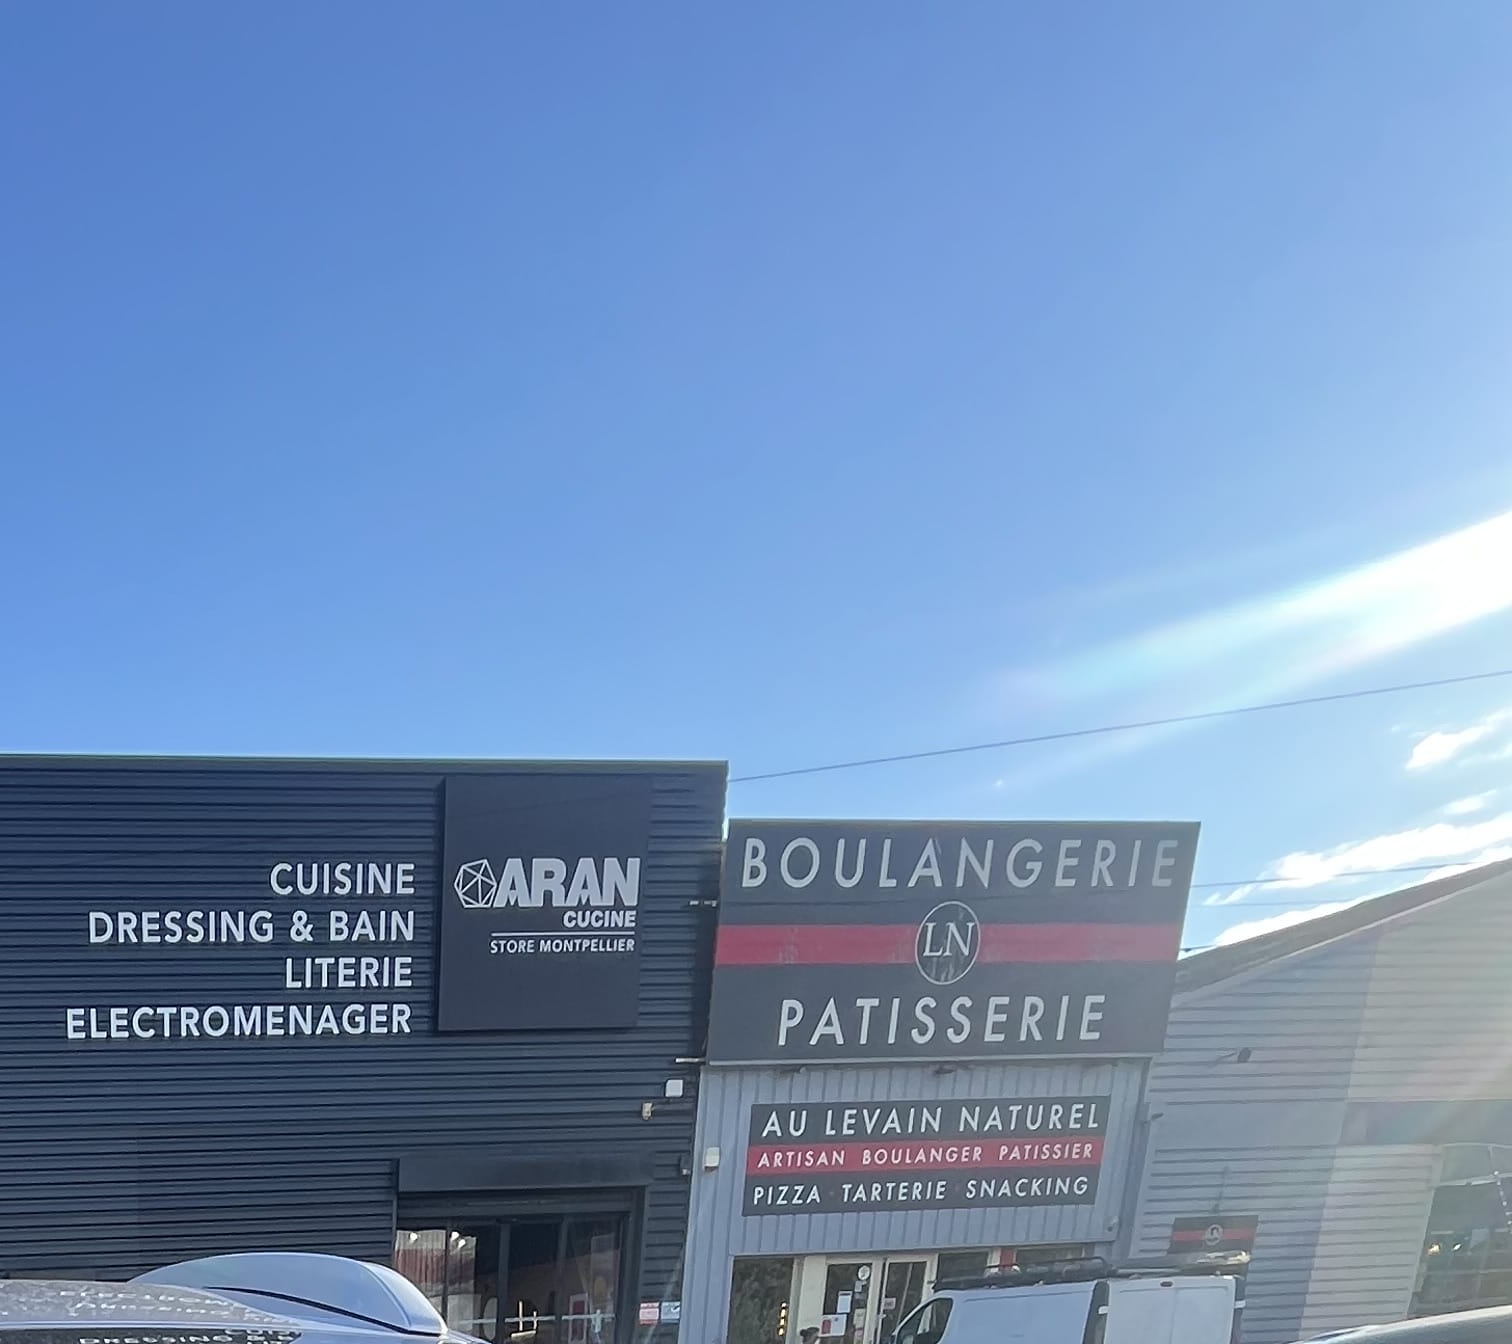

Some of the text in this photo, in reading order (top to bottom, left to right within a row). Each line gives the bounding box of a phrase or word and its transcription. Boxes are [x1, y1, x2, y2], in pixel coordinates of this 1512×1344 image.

[270, 862, 416, 895] CUISINE
[741, 837, 1180, 888] BOULANGERIE
[493, 858, 640, 907] ARAN
[88, 909, 416, 943] DRESSING & BAIN
[563, 910, 637, 928] CUCINE
[490, 938, 635, 954] STORE MONTPELLIER
[923, 922, 976, 957] LN
[285, 957, 413, 989] LITERIE
[66, 1003, 412, 1040] ELECTROMENAGER
[777, 994, 1107, 1047] PATISSERIE
[761, 1102, 1100, 1138] AU LEVAIN NATUREL
[756, 1143, 1094, 1169] ARTISAN BOULANGER PATISSIER
[753, 1176, 1088, 1206] PIZZA TARTERIE SNACKING
